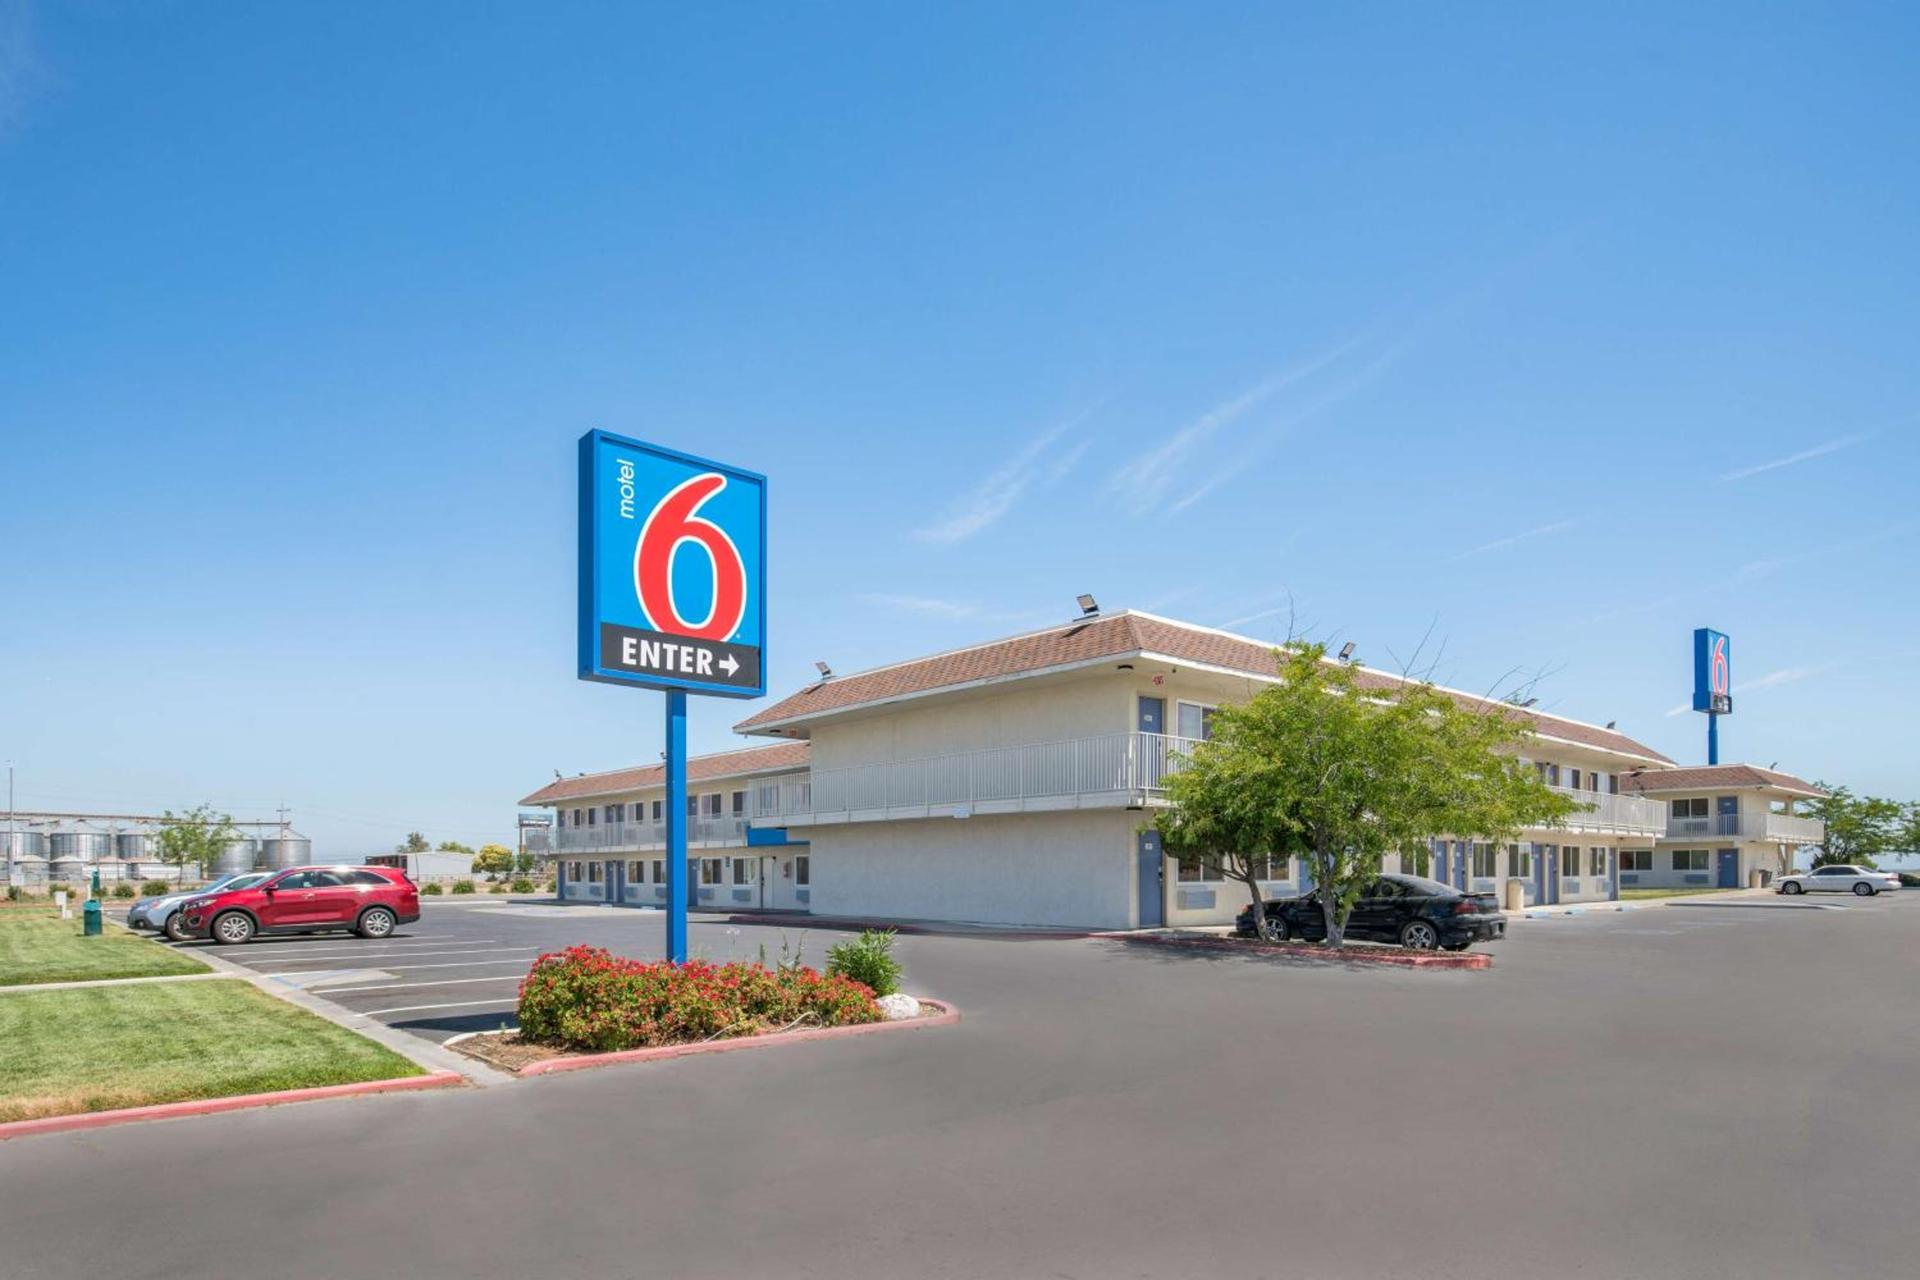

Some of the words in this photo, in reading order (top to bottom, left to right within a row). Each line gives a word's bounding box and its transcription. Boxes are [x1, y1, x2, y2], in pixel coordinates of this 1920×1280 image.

[616, 458, 634, 520] motel
[634, 472, 746, 641] 6
[622, 636, 713, 676] ENTER
[1712, 636, 1728, 695] 6
